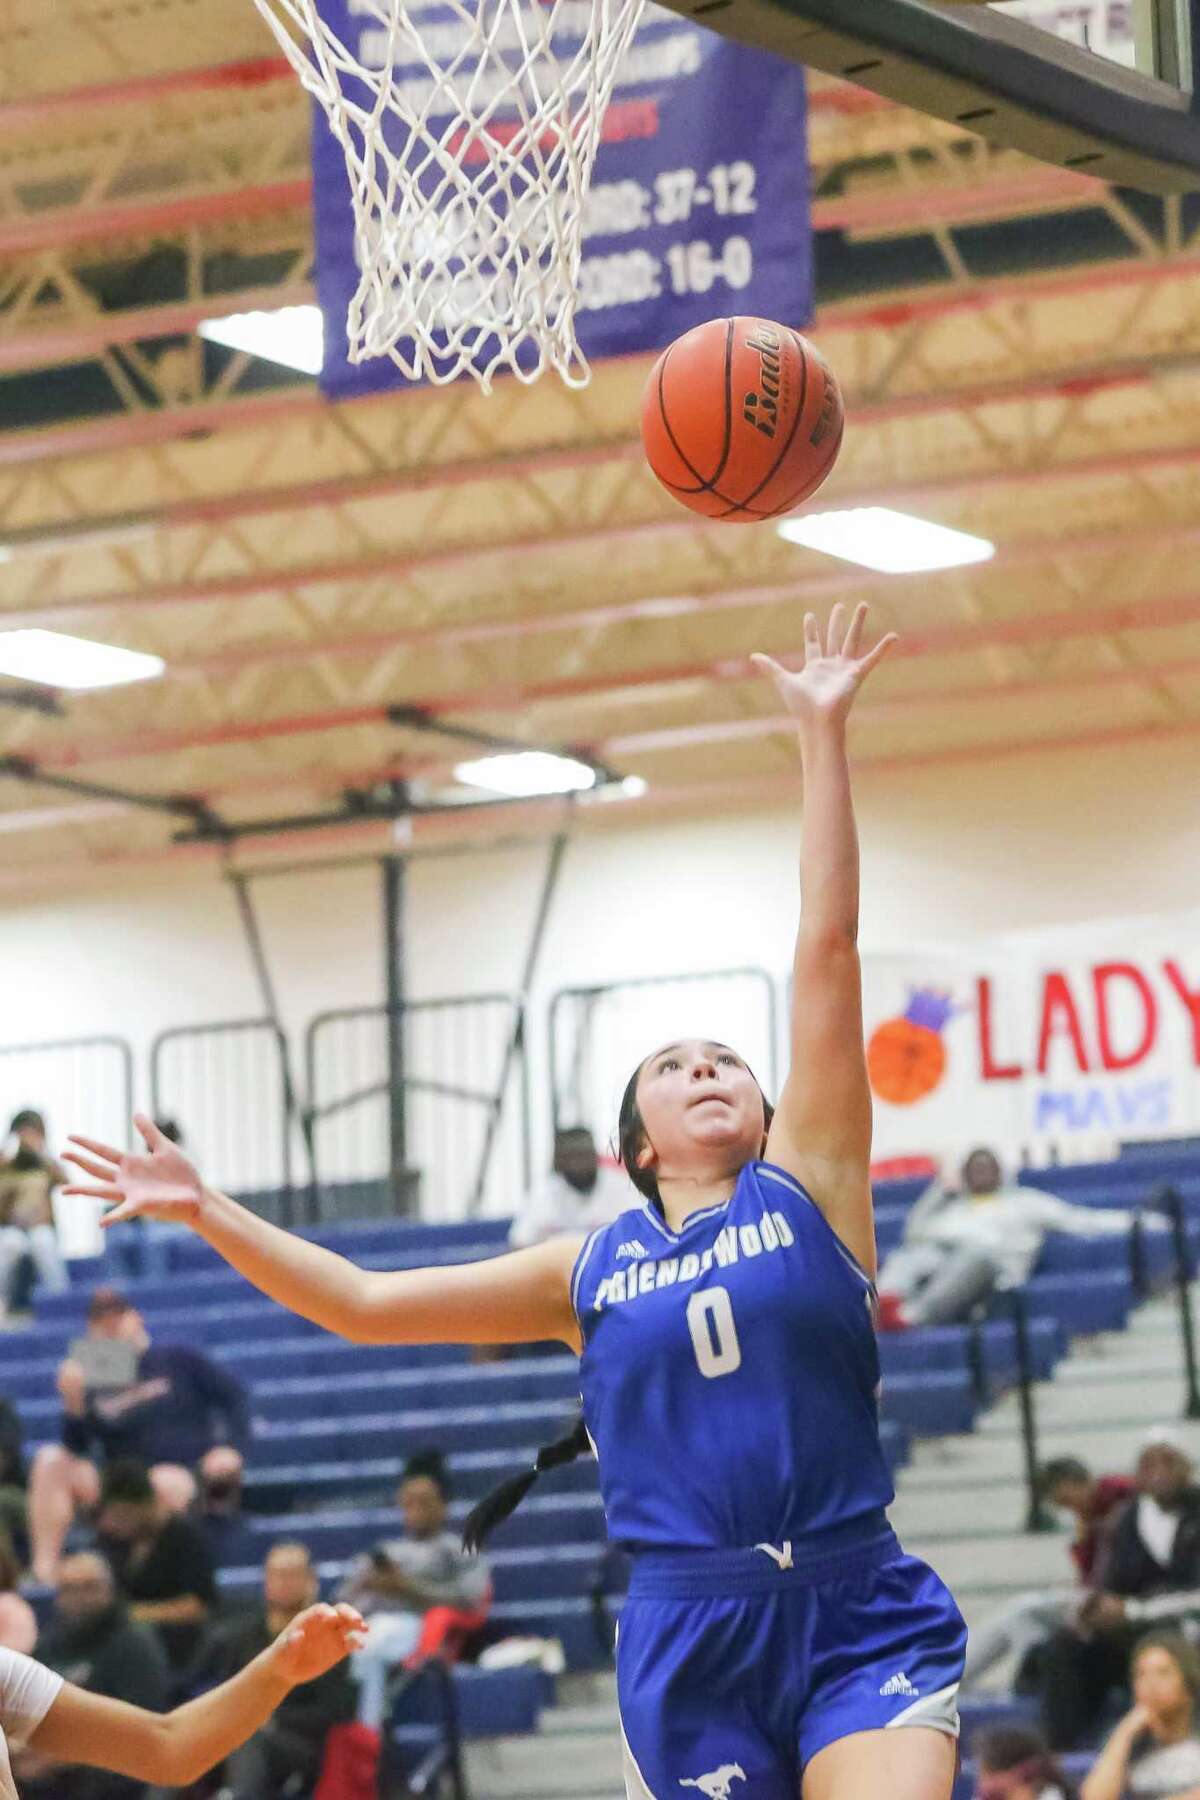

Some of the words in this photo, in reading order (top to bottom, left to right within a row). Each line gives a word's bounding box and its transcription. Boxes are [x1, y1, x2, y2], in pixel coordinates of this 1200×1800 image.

[654, 161, 758, 225] 37-12
[667, 235, 752, 295] 16-0
[976, 958, 1200, 1081] LADY
[686, 1286, 742, 1379] 0
